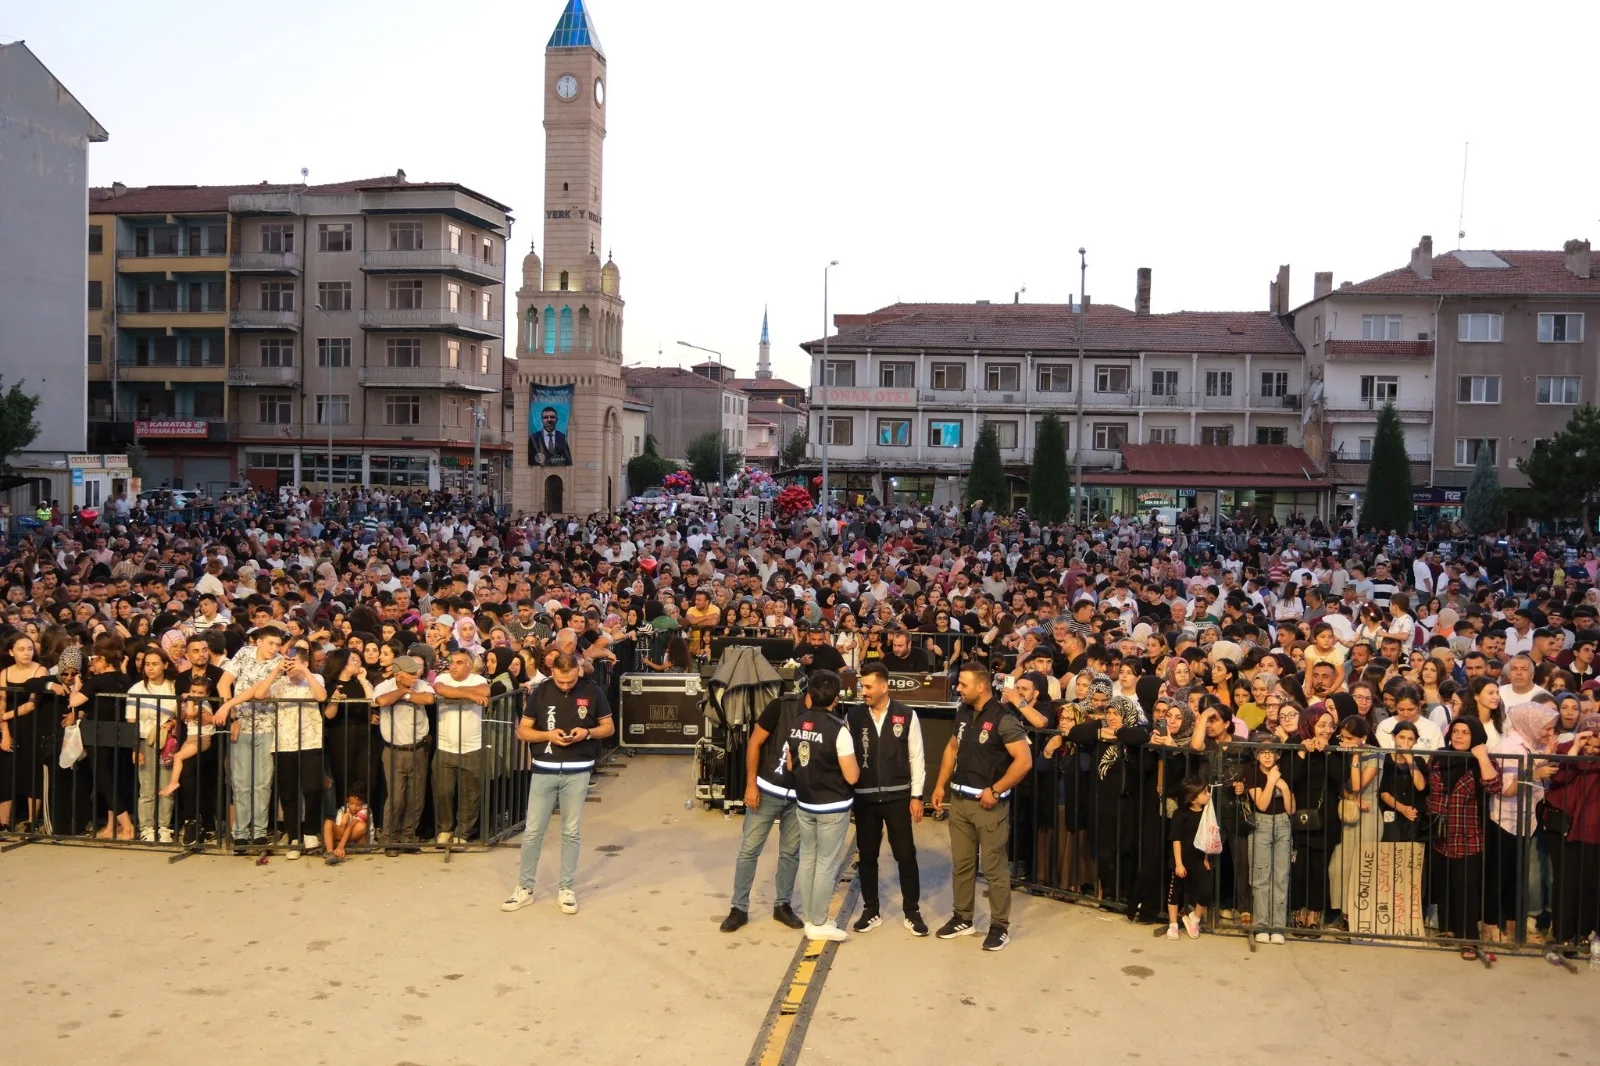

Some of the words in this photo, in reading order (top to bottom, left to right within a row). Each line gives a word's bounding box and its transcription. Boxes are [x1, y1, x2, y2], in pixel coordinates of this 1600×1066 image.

[876, 391, 911, 403] OTEL
[1445, 491, 1461, 501] R2
[790, 728, 823, 744] ZABITA
[862, 727, 870, 769] ZABITA
